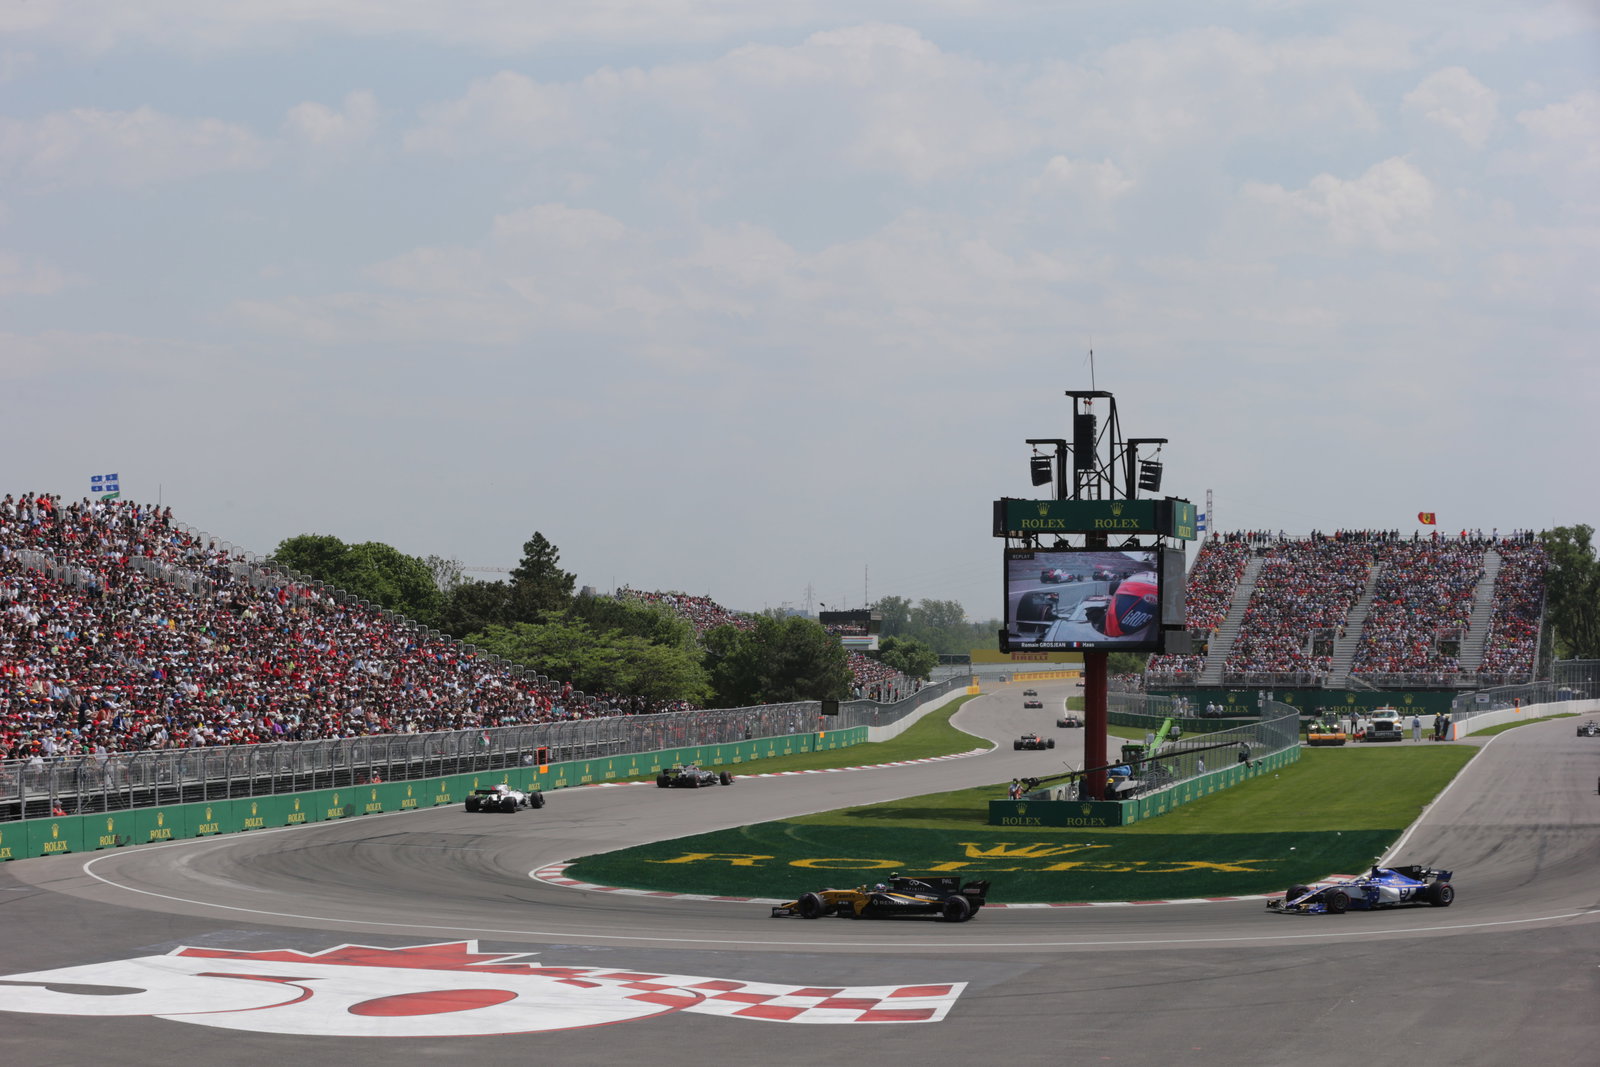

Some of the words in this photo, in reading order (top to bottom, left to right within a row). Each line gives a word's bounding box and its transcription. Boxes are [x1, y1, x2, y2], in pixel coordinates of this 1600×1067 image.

[1021, 519, 1067, 528] ROLEX
[1094, 519, 1140, 528] ROLEX
[1178, 526, 1192, 537] ROLEX
[1215, 705, 1249, 713] OLEX
[366, 803, 382, 812] ROLEX
[402, 799, 417, 808] ROLEX
[328, 808, 344, 817] ROLEX
[245, 817, 263, 827] ROLEX
[288, 813, 305, 823] ROLEX
[1002, 817, 1042, 826] ROLEX
[1067, 817, 1107, 826] ROLEX
[199, 823, 219, 833] ROLEX
[150, 828, 171, 839] ROLEX
[44, 840, 68, 853] ROLEX
[644, 852, 1288, 872] ROLEX
